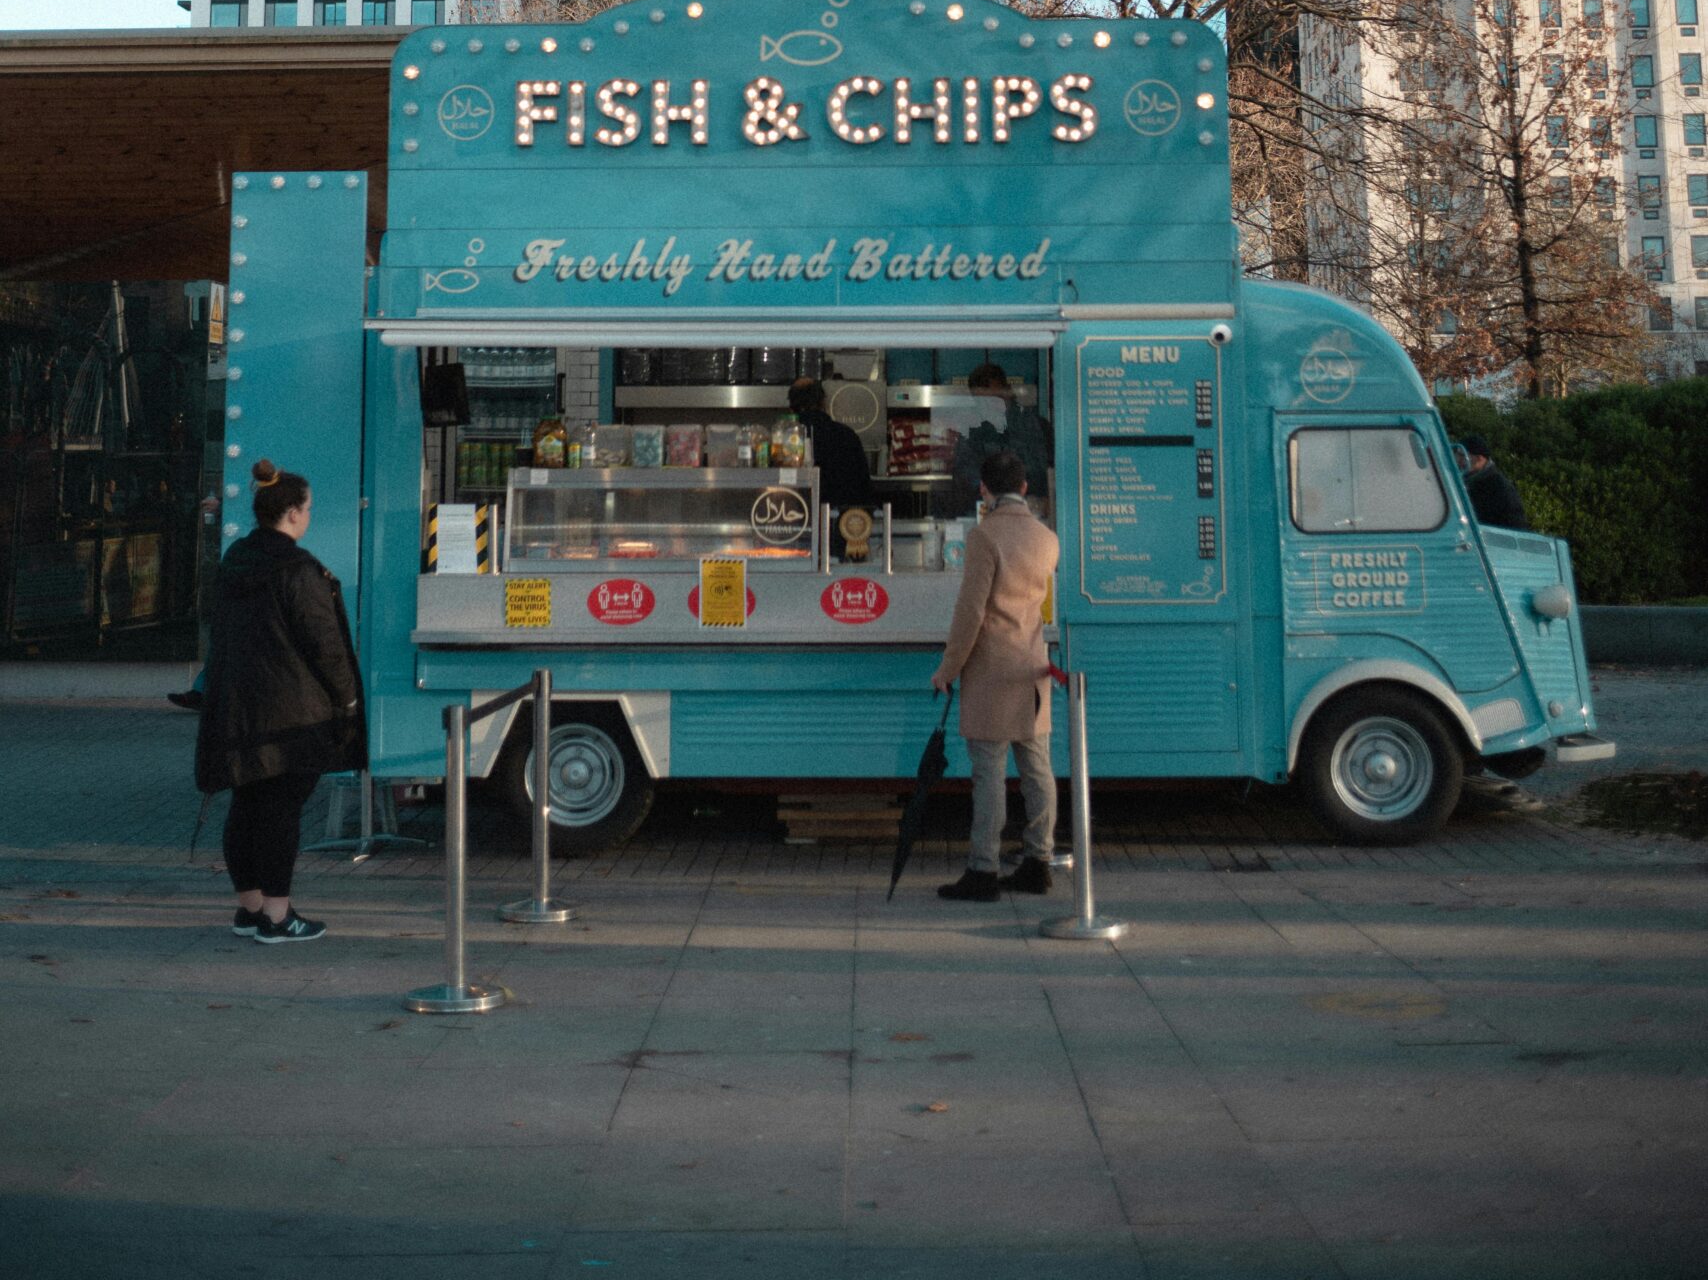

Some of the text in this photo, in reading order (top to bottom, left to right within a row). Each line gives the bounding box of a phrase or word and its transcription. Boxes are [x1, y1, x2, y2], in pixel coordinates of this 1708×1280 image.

[515, 72, 1100, 146] FISH & CHIPS
[513, 235, 1051, 297] Freshly Hand Battered
[1121, 346, 1180, 363] MENU
[1088, 368, 1125, 378] FOOD
[755, 496, 805, 524] حلال
[1090, 504, 1136, 515] DRINKS
[1331, 552, 1407, 568] FRESHLY
[509, 582, 525, 590] STAY
[1332, 571, 1409, 587] GROUND
[509, 594, 546, 602] CONTROL
[1333, 591, 1406, 607] COFFEE
[510, 603, 547, 611] THE VIRUS
[509, 615, 547, 624] SAVE LIVES
